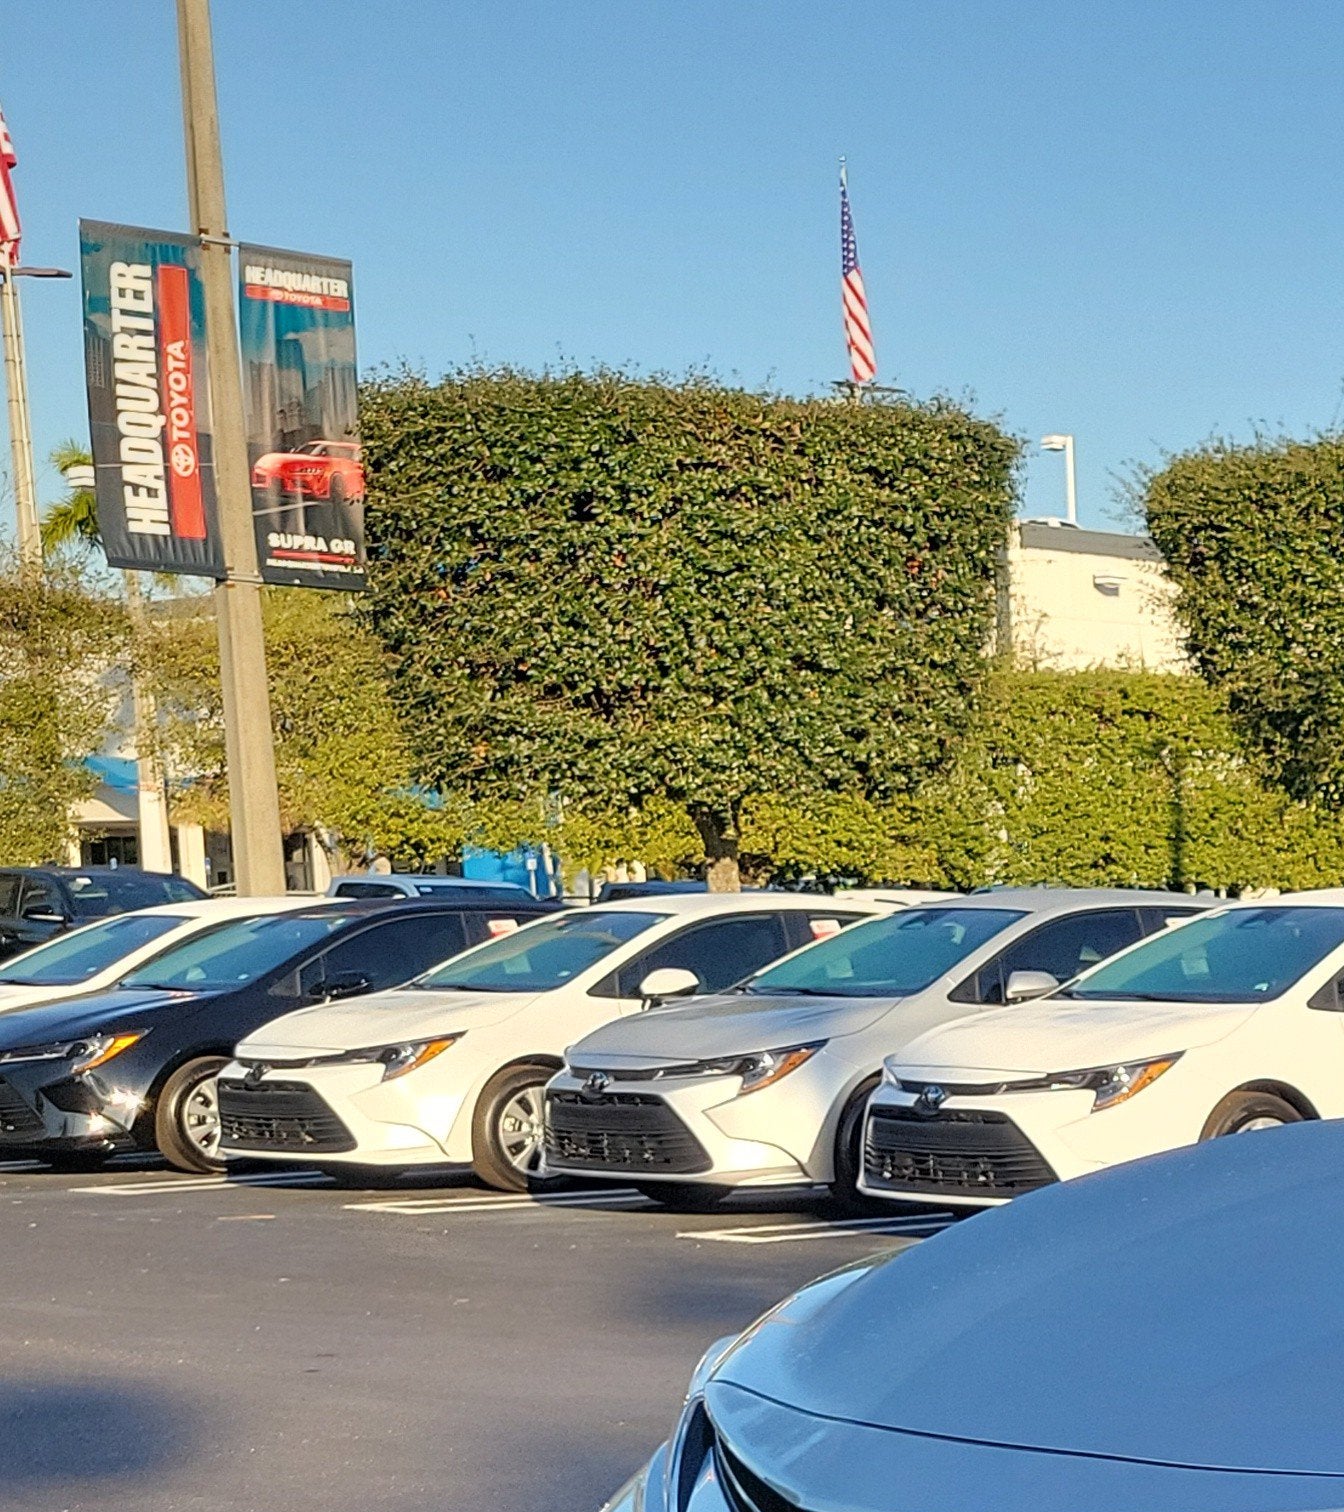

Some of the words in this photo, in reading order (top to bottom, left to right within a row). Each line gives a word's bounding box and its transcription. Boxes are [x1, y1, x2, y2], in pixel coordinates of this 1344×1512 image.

[244, 264, 349, 298] HEADQUARTER
[284, 291, 323, 306] TOYOTA
[109, 261, 171, 536] HEADQUARTER
[166, 340, 191, 442] TOYOTA
[267, 532, 329, 552] SUPRA
[329, 538, 357, 555] GR
